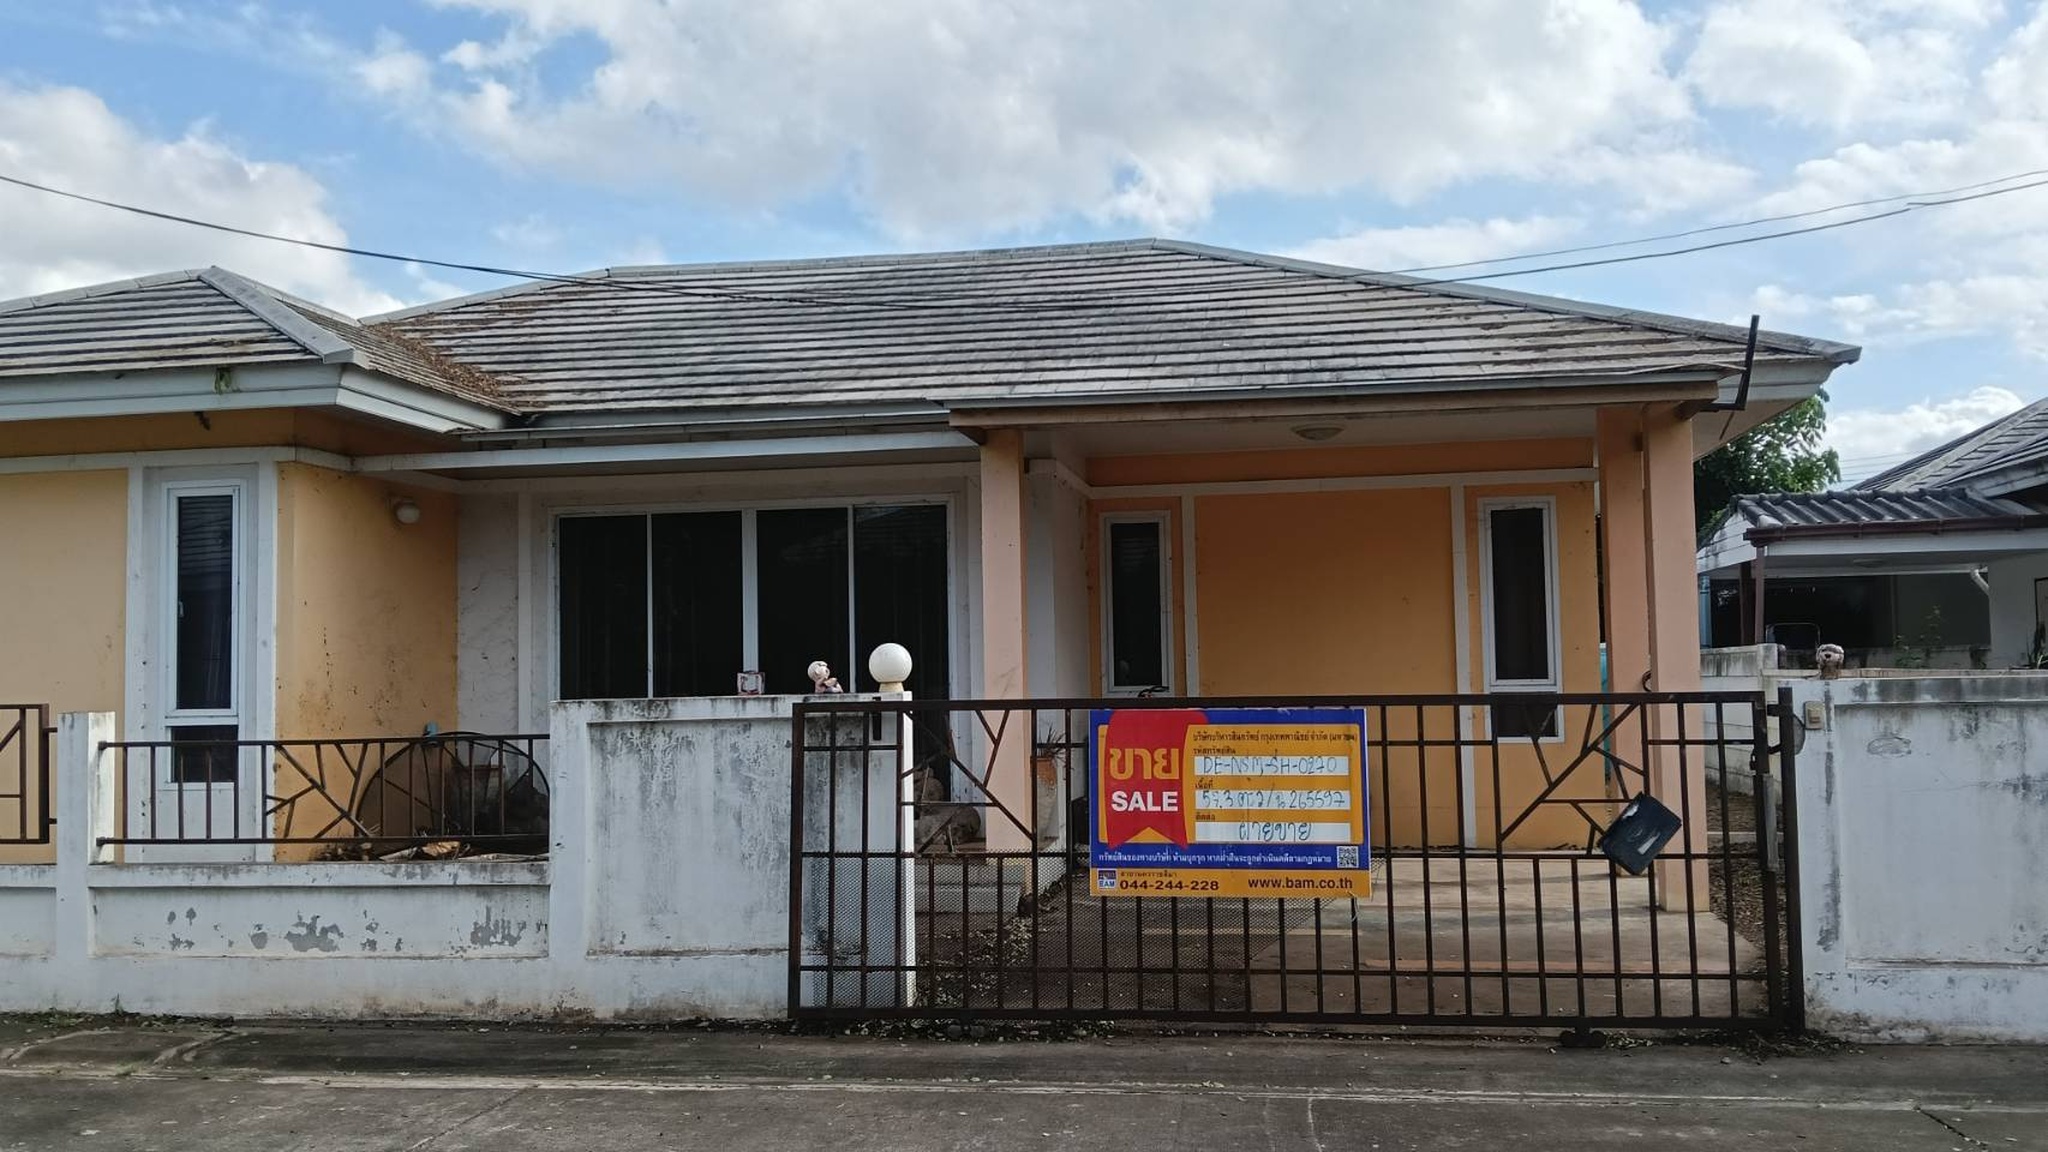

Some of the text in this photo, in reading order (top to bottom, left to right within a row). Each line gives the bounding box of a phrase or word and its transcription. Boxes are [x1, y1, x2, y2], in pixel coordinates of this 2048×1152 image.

[1109, 748, 1179, 780] ขาย
[1111, 791, 1179, 812] SALE
[1120, 880, 1219, 891] 044-244-228
[1248, 877, 1353, 889] www.bam.co.th
